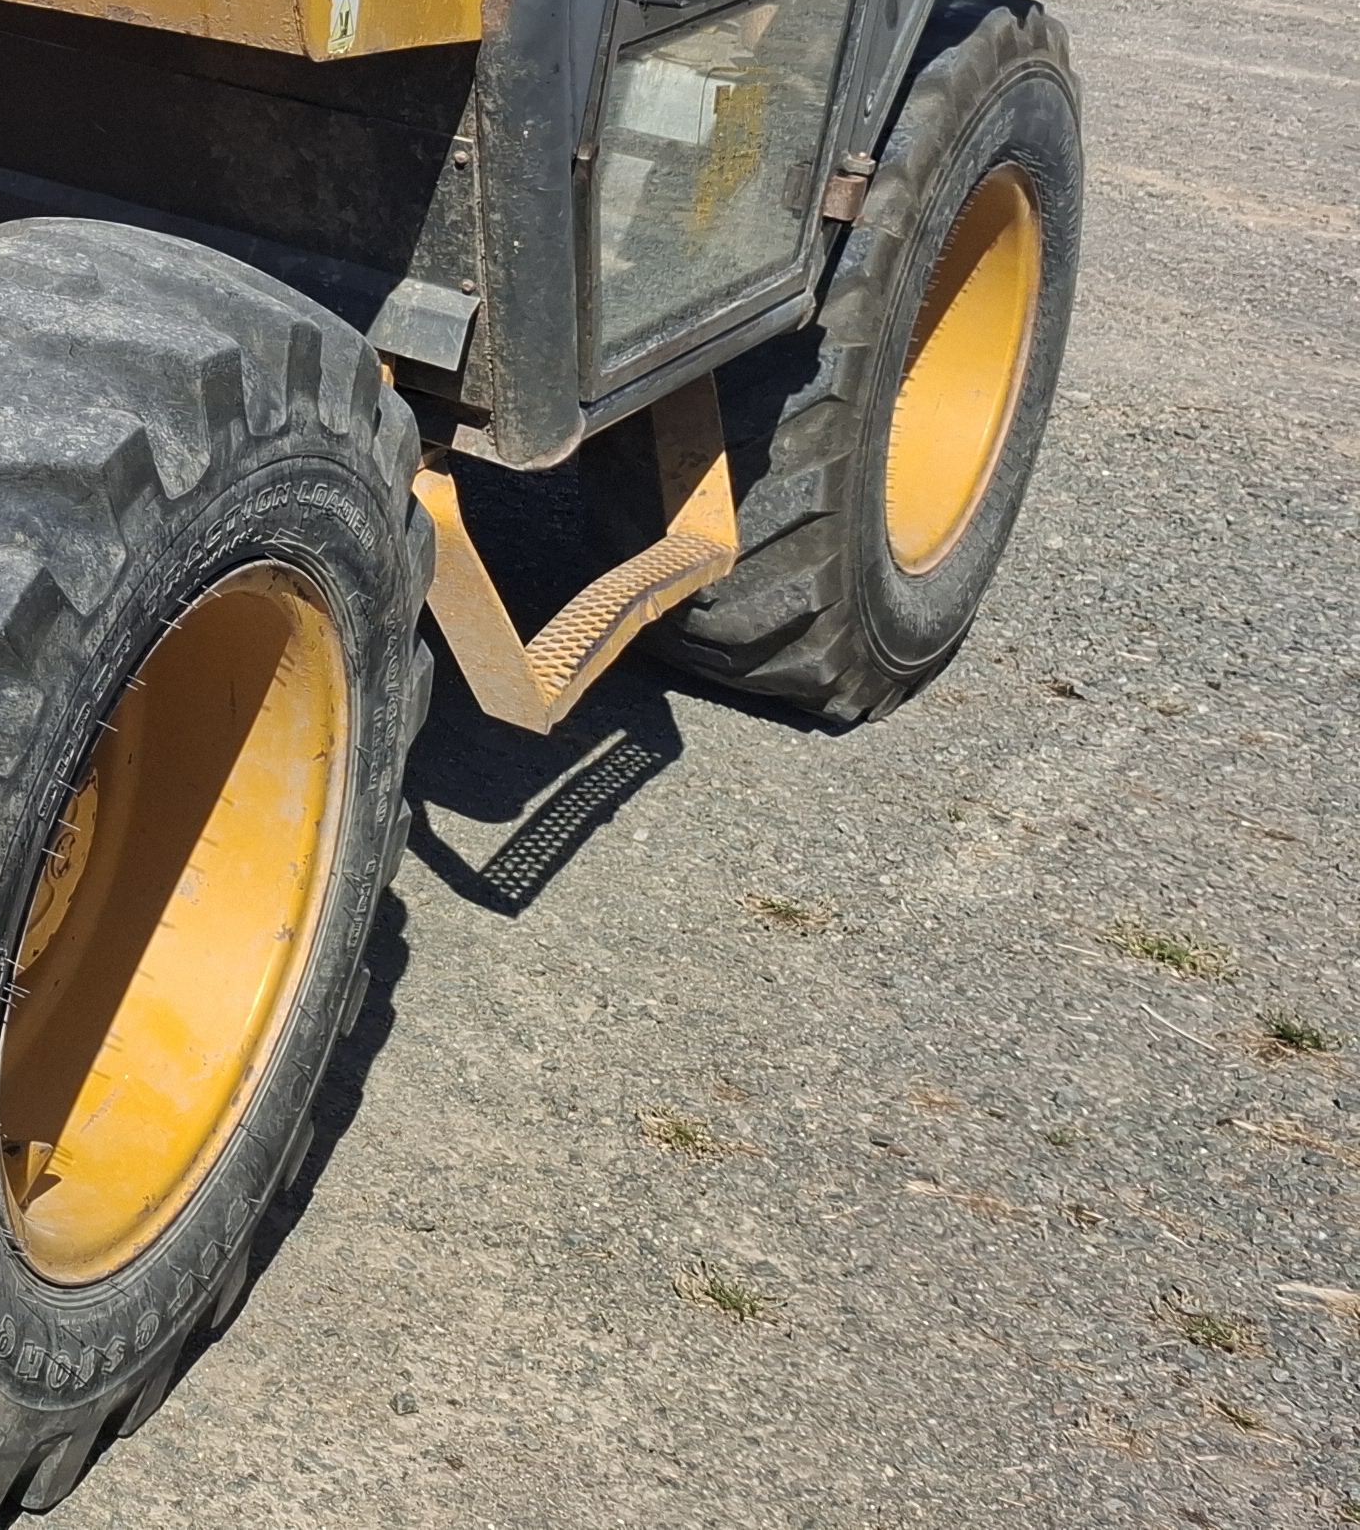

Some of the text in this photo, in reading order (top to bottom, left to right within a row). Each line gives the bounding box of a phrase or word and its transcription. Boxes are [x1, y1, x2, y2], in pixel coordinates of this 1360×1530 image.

[38, 630, 132, 821] SUPER
[145, 483, 291, 618] TRACTION
[297, 479, 377, 550] LOADER
